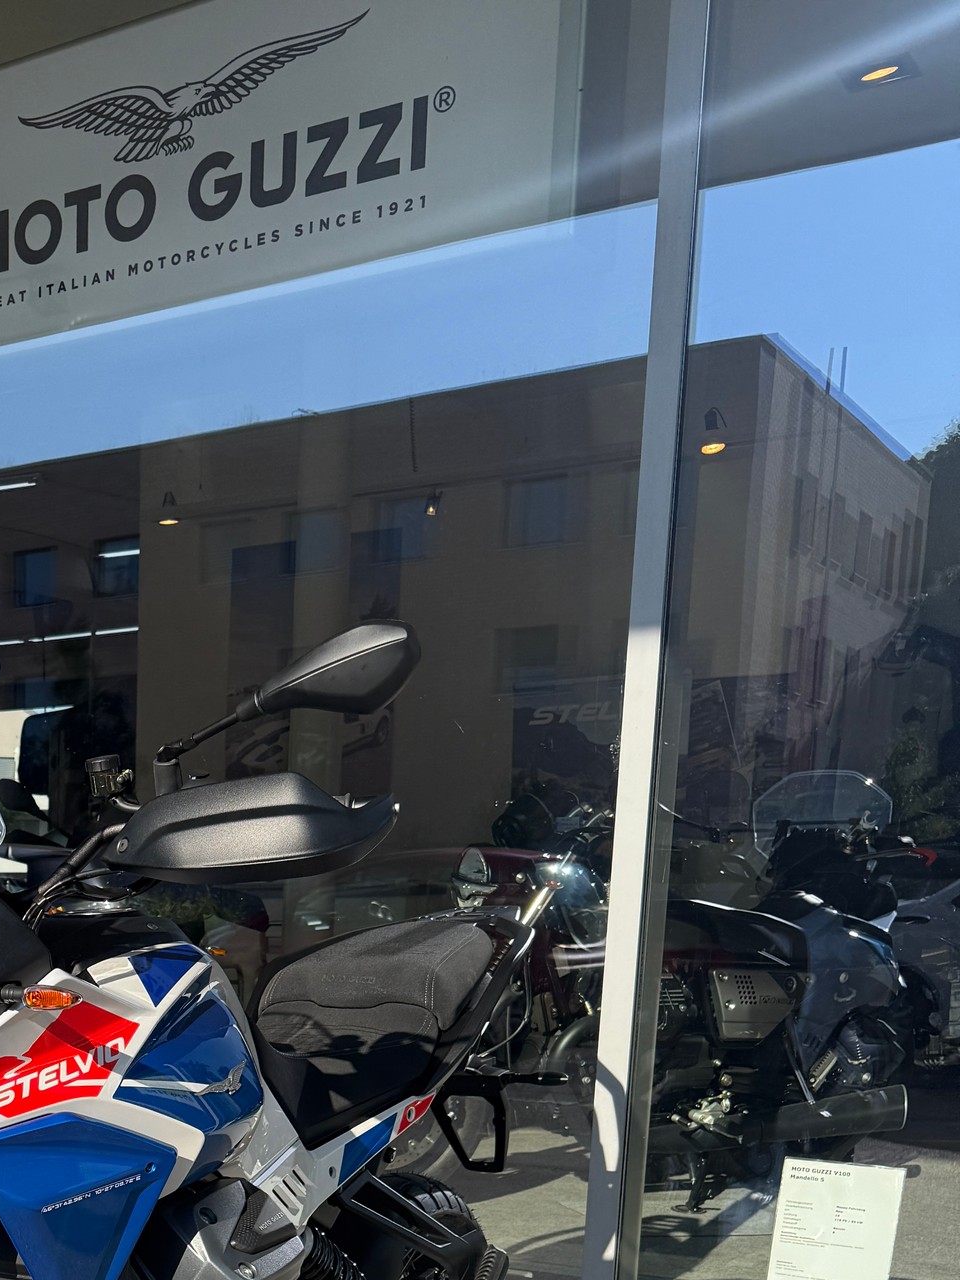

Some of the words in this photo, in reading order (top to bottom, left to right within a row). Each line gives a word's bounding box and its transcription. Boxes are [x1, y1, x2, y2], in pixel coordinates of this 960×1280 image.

[38, 269, 116, 298] ITALIAN
[128, 230, 280, 276] MOTORCYCLES
[294, 210, 363, 238] SINCE
[376, 195, 428, 219] 1921
